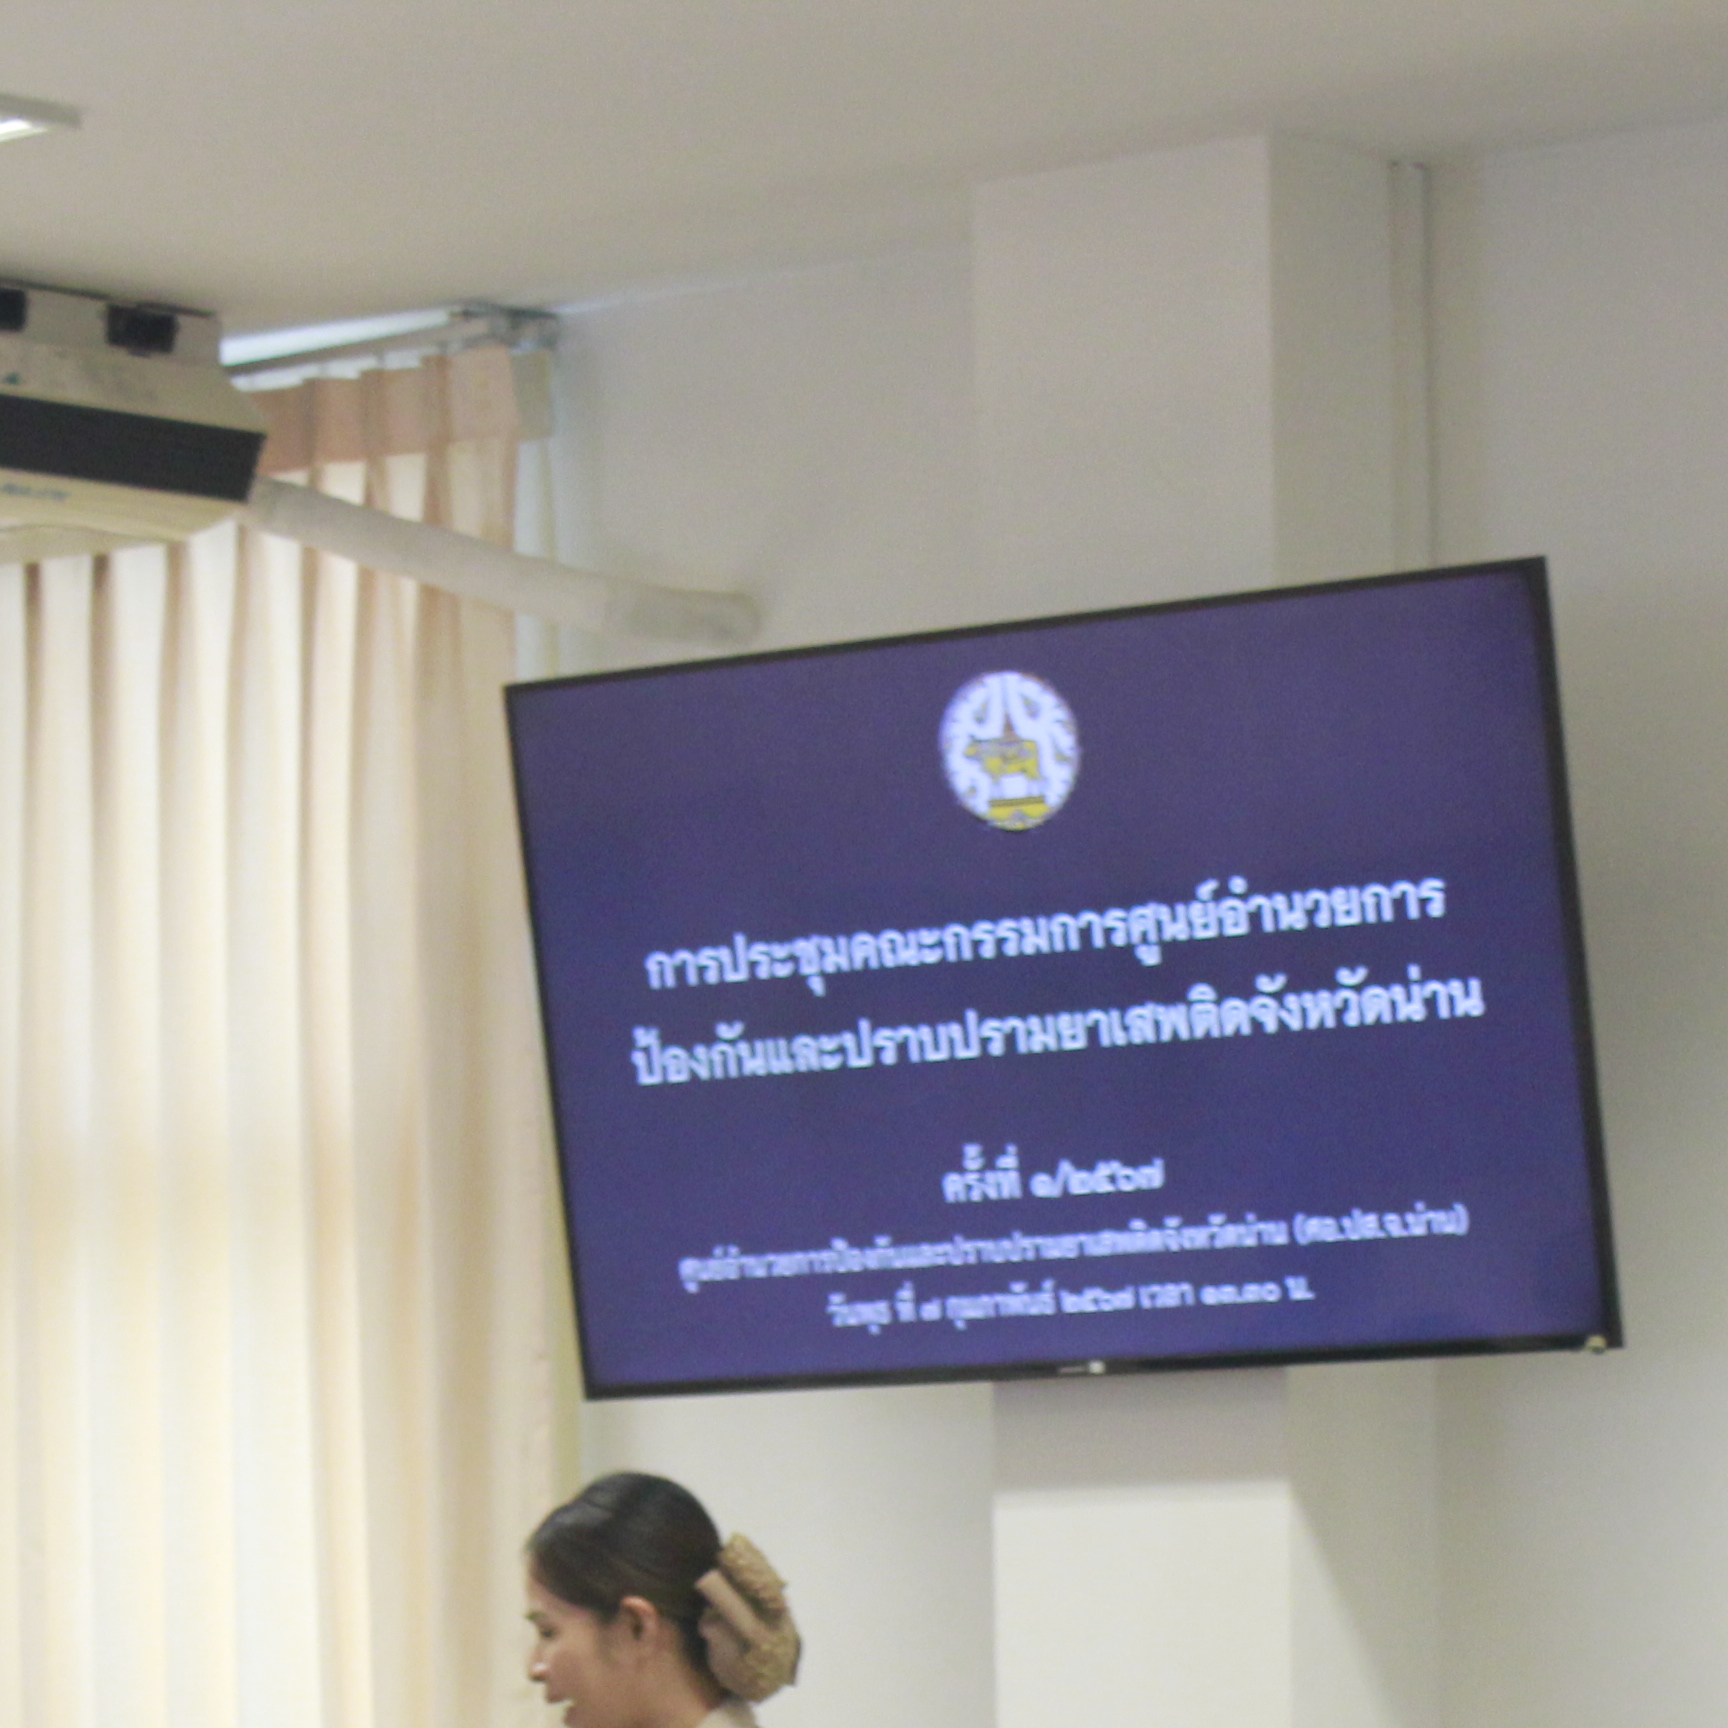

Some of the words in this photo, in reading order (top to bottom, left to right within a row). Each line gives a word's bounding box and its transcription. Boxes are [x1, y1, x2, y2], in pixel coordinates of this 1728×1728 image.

[645, 876, 1446, 997] การประชุมคณะกรรมการศูนย์อำนวยการ
[630, 966, 1486, 1086] ป้องกันและปราบปรามยาเสพติดจังหวัดน่าน
[942, 1143, 1022, 1203] ครั้งที่
